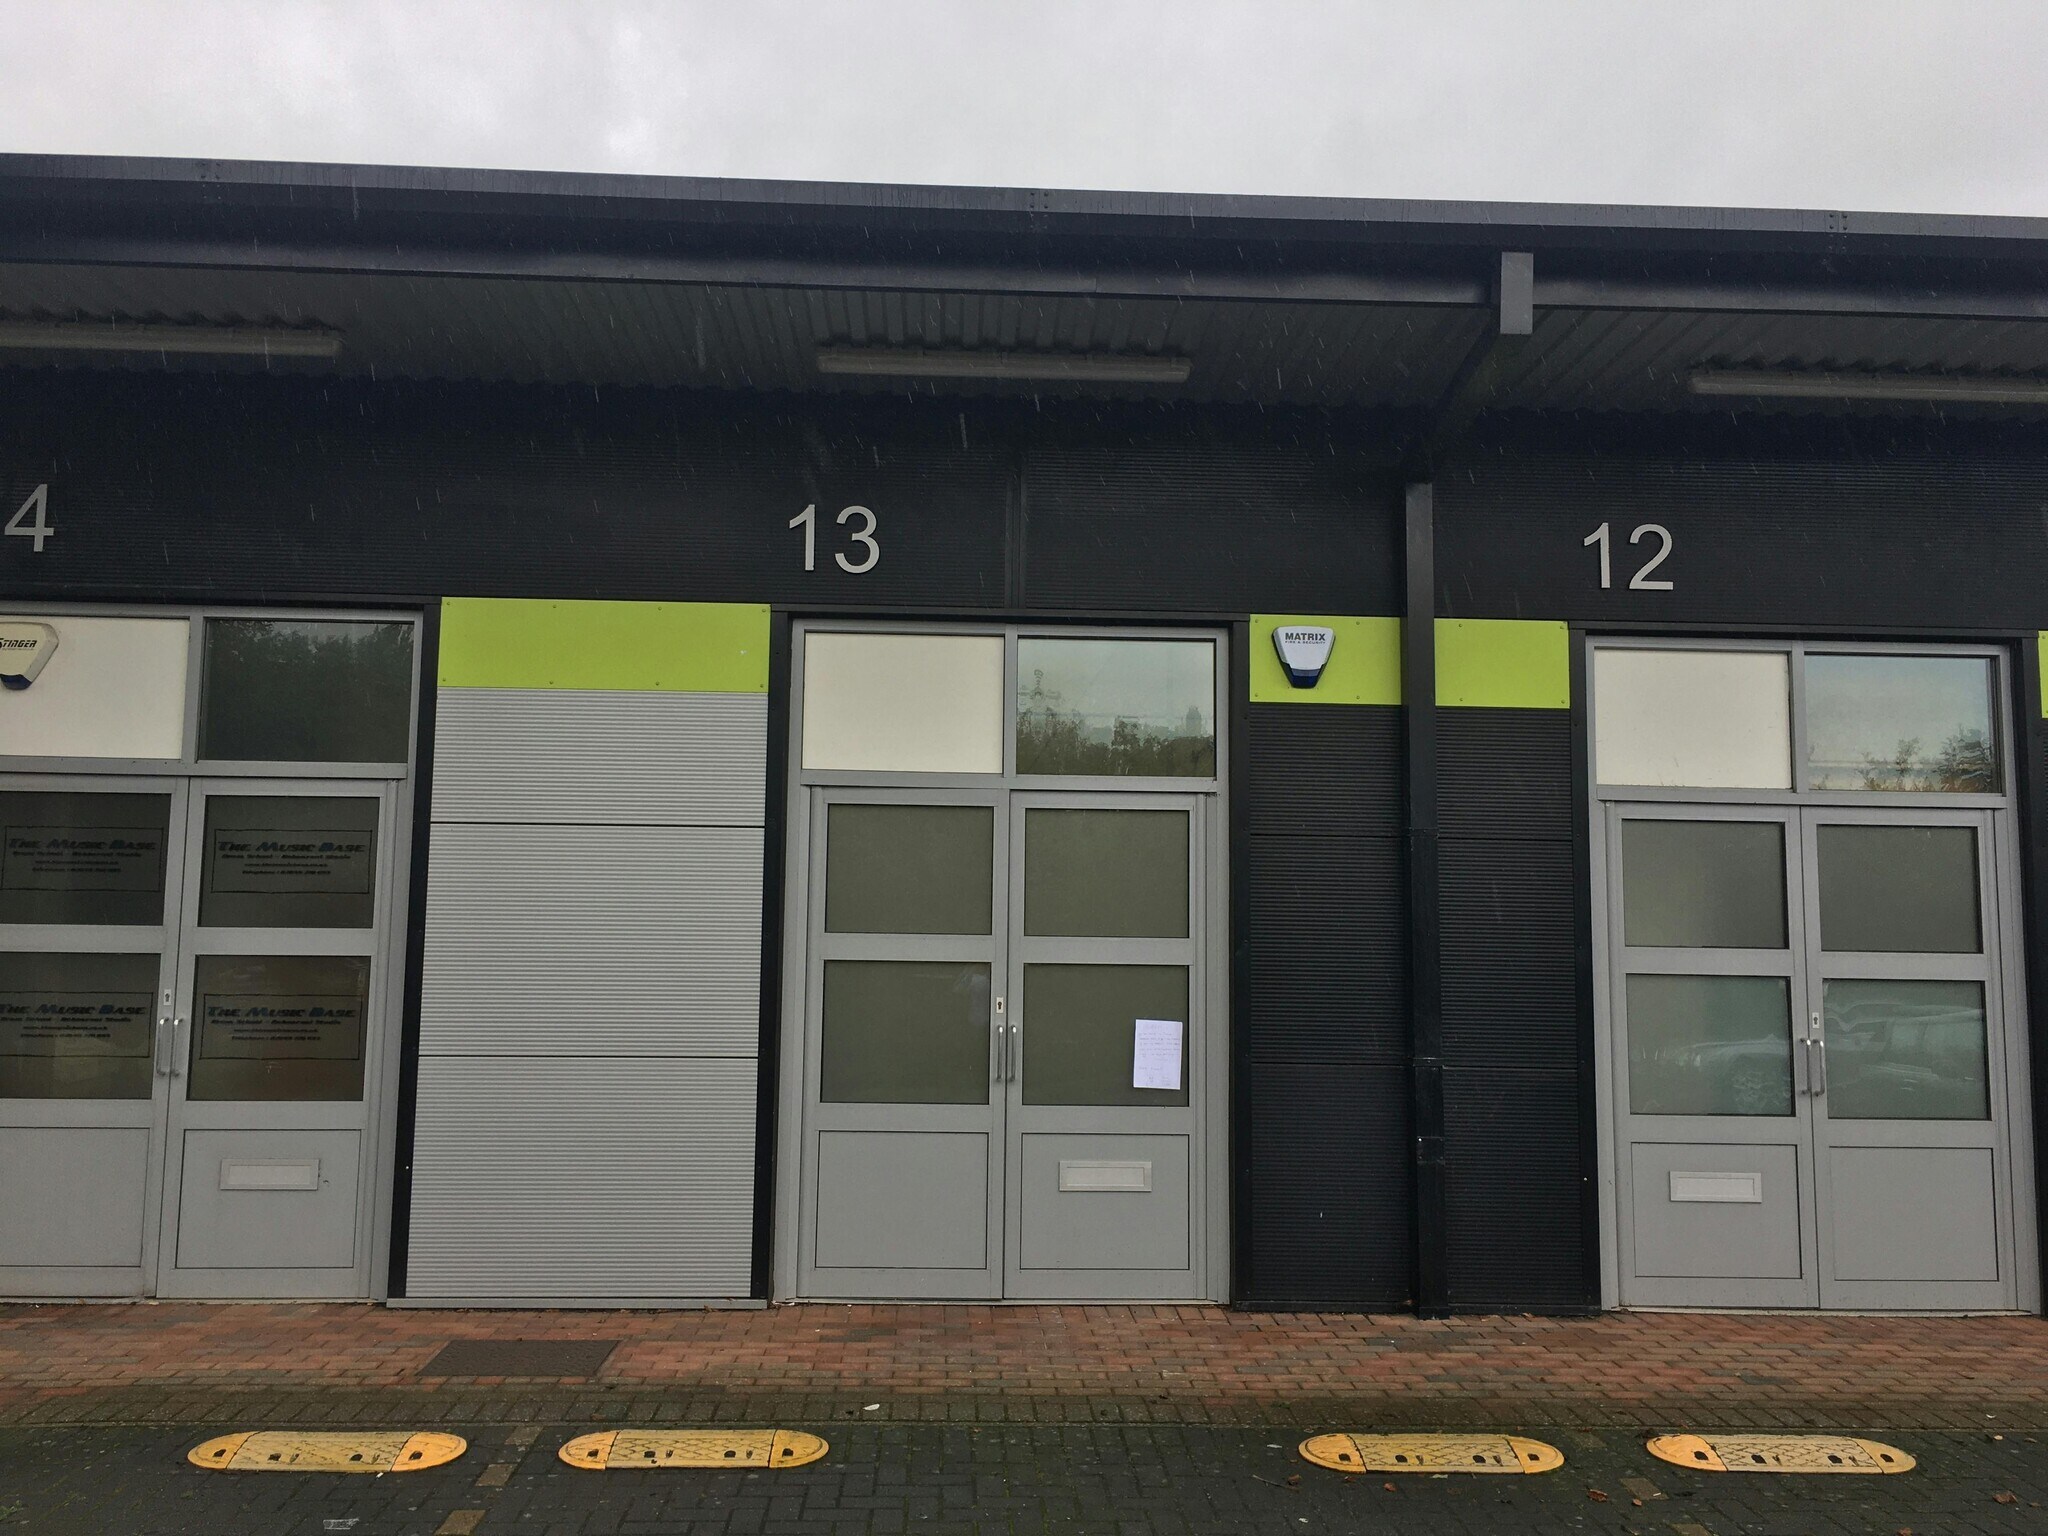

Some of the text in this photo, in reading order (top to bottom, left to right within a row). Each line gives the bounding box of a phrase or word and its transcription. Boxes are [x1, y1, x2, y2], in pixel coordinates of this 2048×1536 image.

[4, 483, 55, 552] 4
[789, 504, 880, 574] 13
[1583, 522, 1674, 591] 12
[1285, 632, 1326, 641] MATRIX
[47, 839, 107, 849] MUSIC
[218, 841, 365, 852] THE MUSIC BASE
[35, 1004, 96, 1014] MUSIC
[99, 1004, 146, 1015] BASE
[207, 1006, 356, 1017] THE MUSIC BASE
